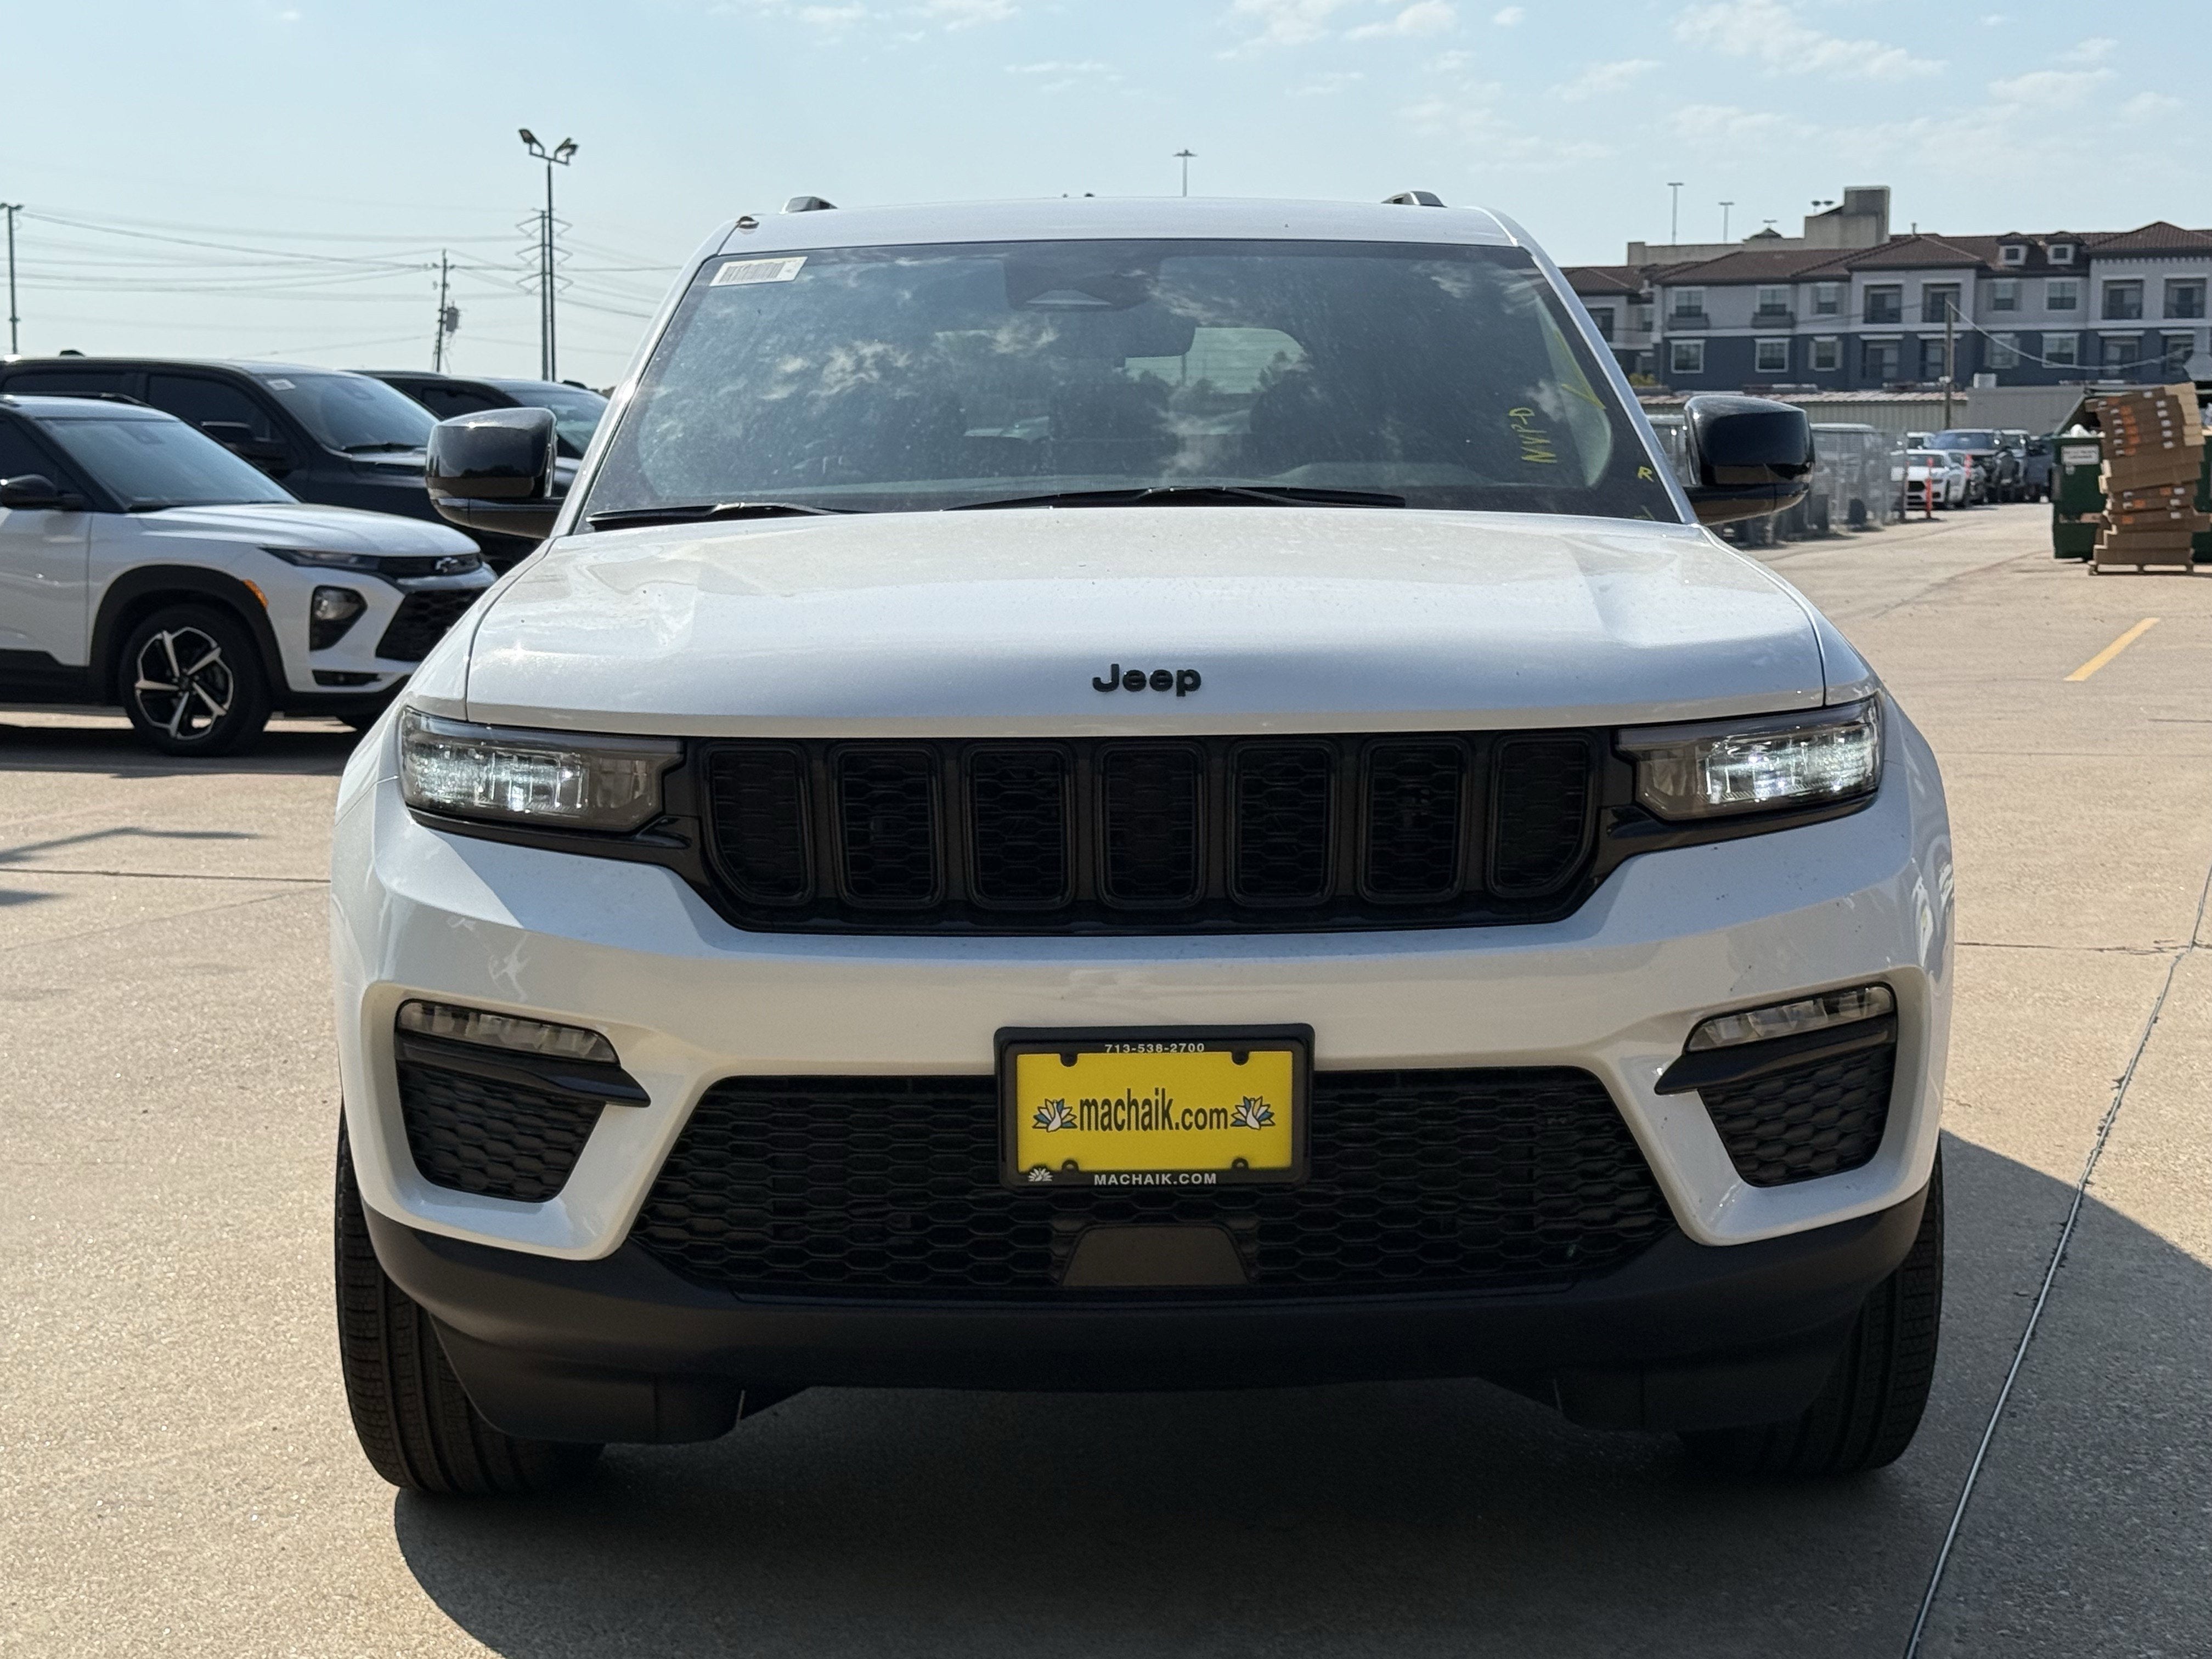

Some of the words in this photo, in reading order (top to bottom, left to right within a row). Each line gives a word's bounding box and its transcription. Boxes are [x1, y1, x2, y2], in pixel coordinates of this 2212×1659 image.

[1638, 466, 1654, 482] R
[1092, 663, 1201, 697] Jeep
[1104, 1043, 1205, 1053] 713-538-2700
[1079, 1087, 1228, 1131] machaik.com
[1094, 1173, 1217, 1186] MACHAIK.COM
